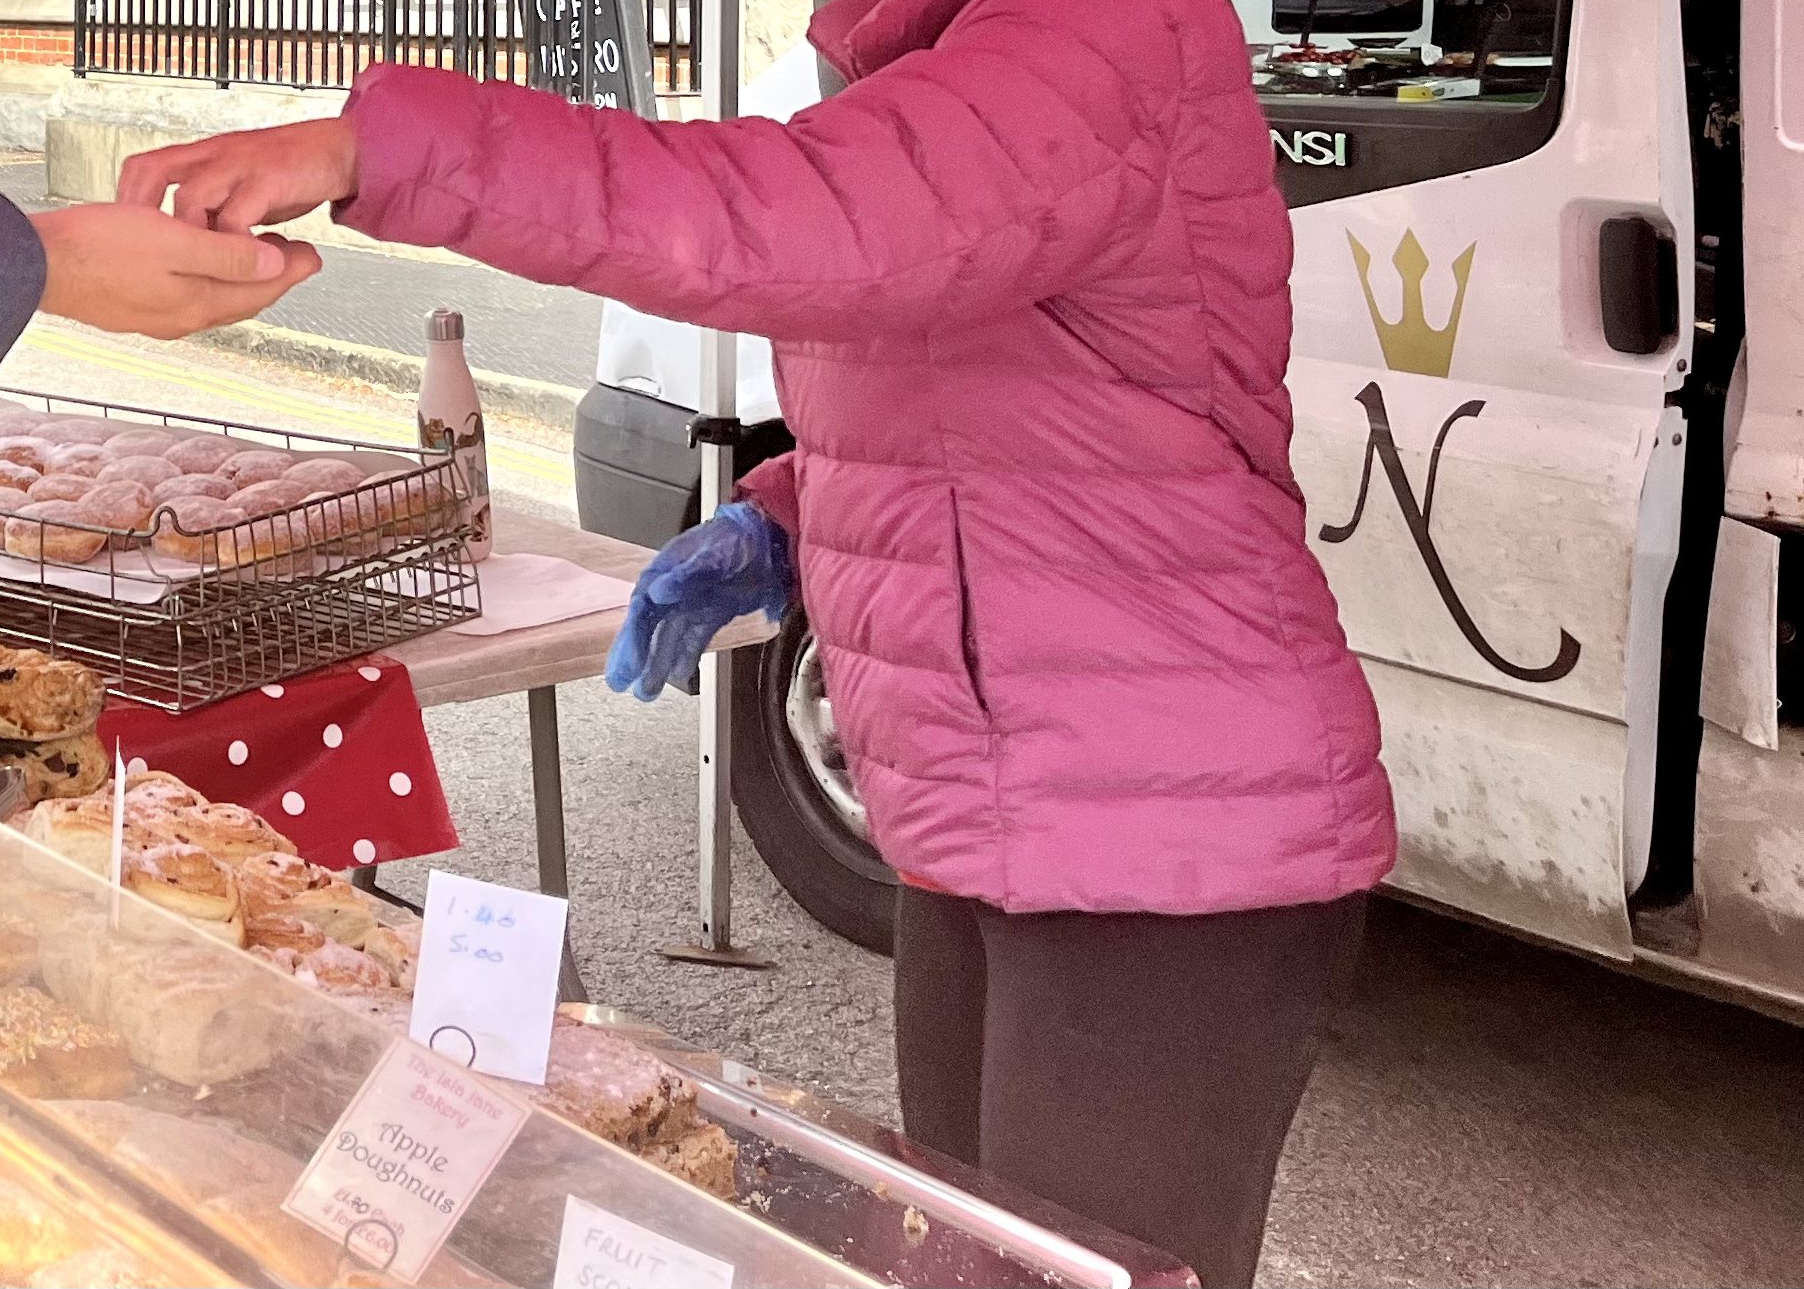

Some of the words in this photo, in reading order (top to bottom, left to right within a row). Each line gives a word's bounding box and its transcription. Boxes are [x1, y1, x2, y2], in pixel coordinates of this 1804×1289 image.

[1317, 380, 1582, 683] N
[410, 1083, 471, 1129] Bakery
[335, 1130, 456, 1214] Doughnuts
[379, 1121, 449, 1173] Apple
[584, 1226, 668, 1275] FRUIT
